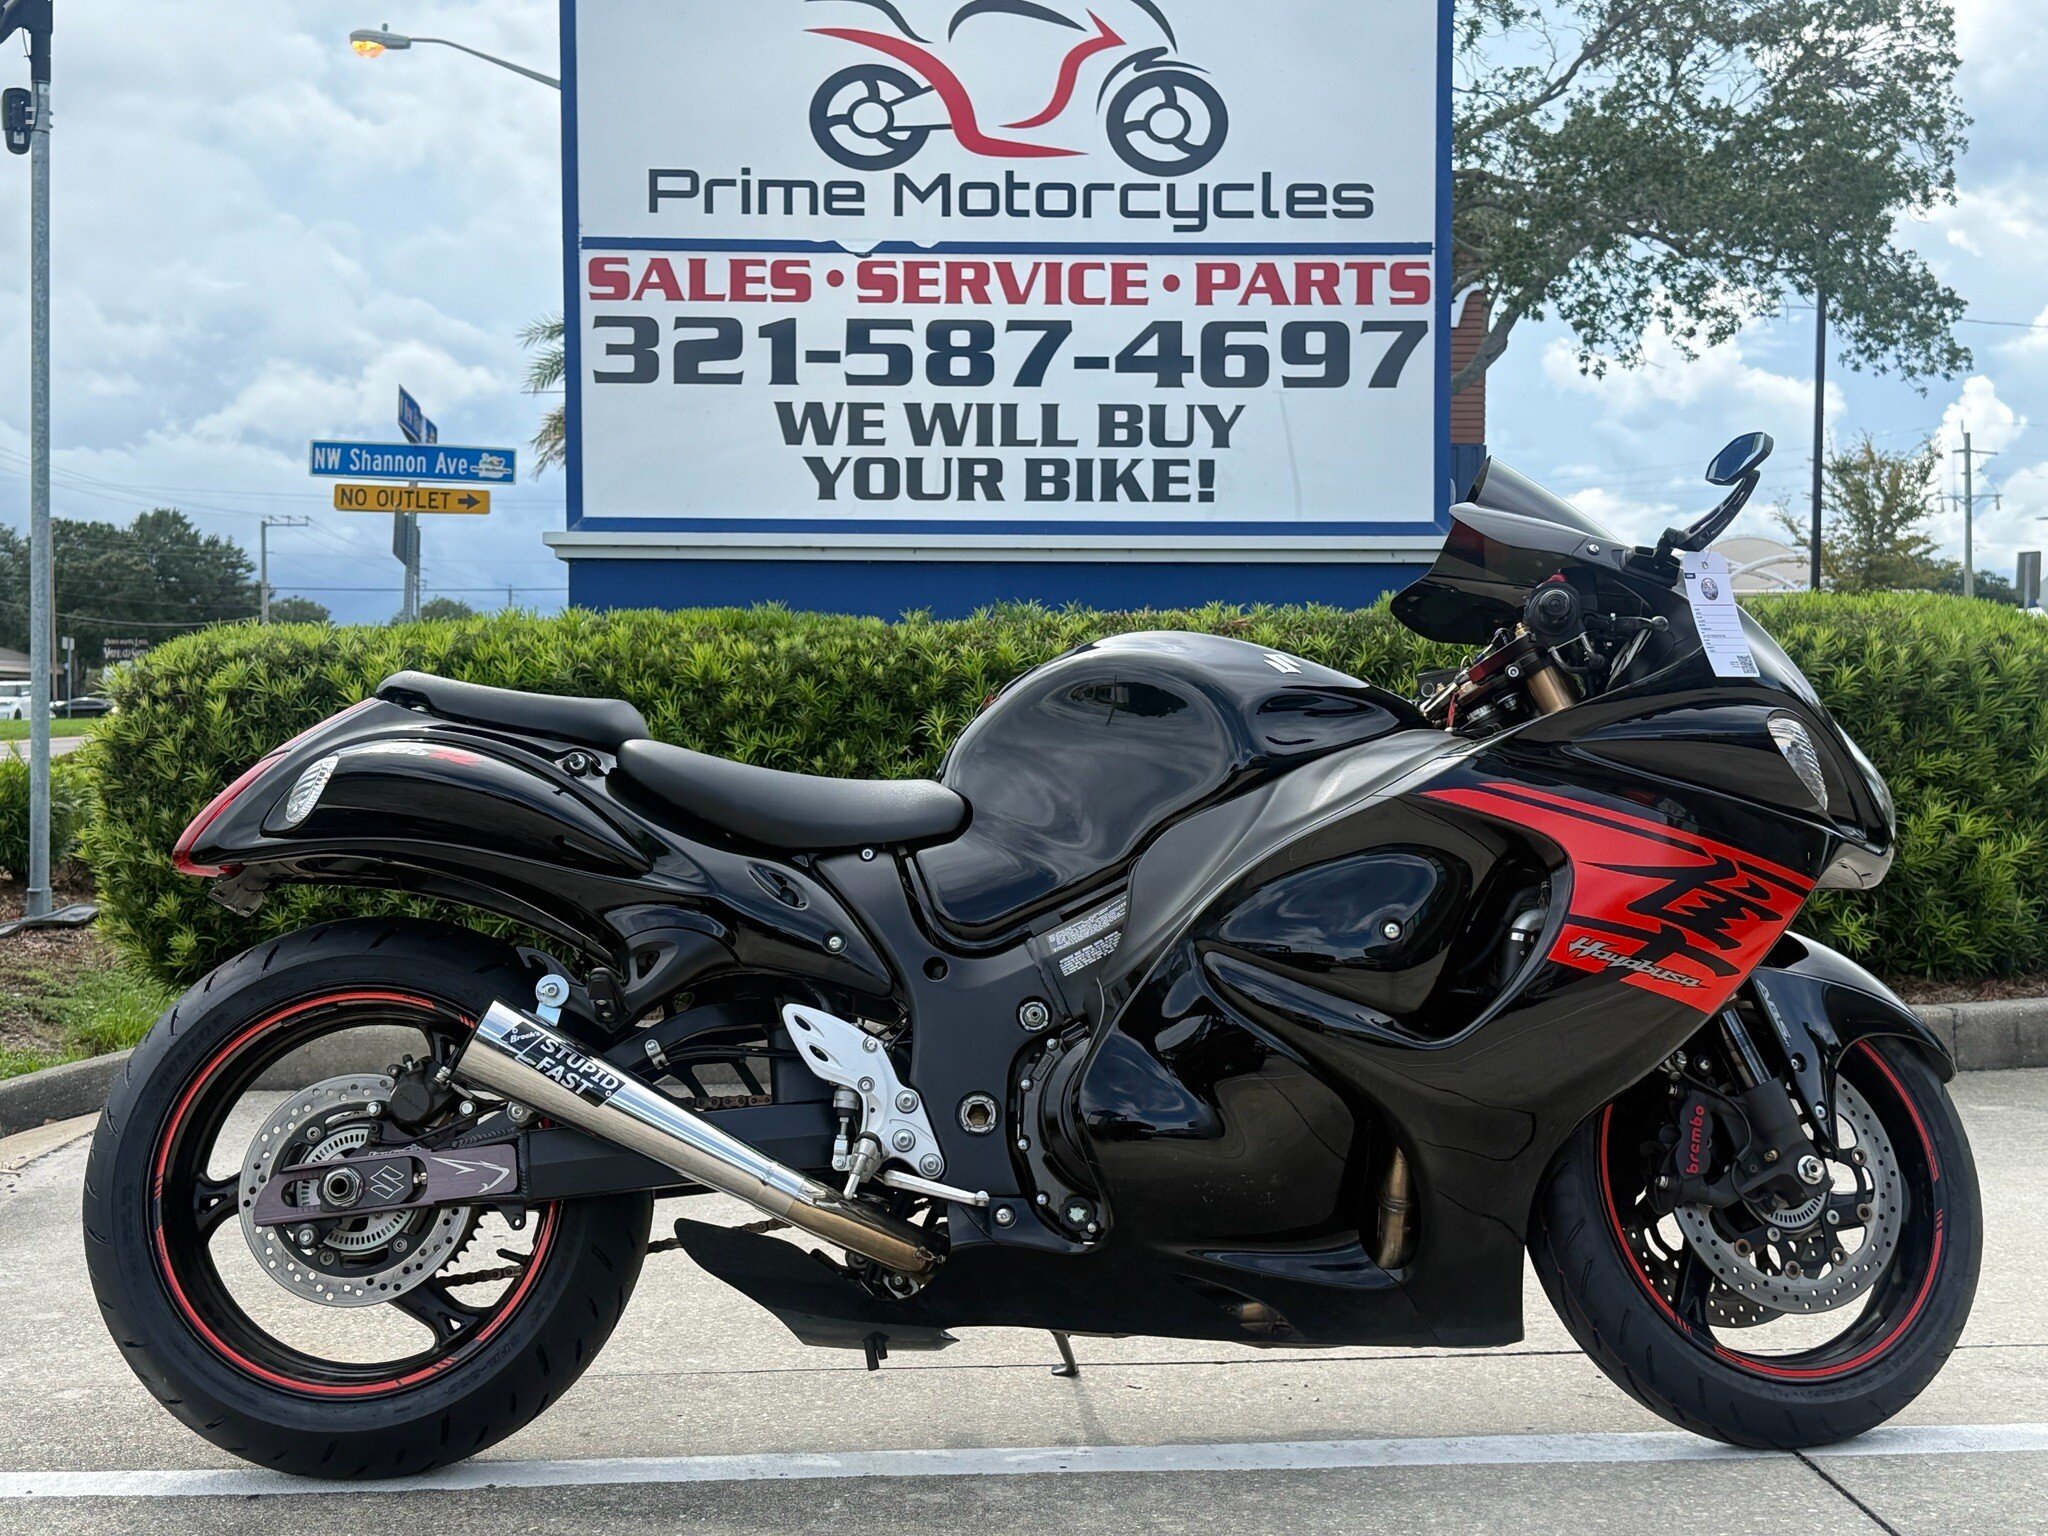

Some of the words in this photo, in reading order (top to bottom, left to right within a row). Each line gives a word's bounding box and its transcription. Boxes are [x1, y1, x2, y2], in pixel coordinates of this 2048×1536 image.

[648, 167, 865, 217] Prime
[894, 171, 1374, 233] Motorcycles
[588, 257, 812, 303] SALES
[857, 261, 1149, 305] SERVICE
[1196, 262, 1431, 306] PARTS
[592, 315, 1429, 389] 321-587-4697
[774, 402, 886, 446] WE
[903, 403, 1078, 448] WILL
[1097, 404, 1246, 449] BUY
[314, 447, 341, 470] NW
[350, 448, 427, 474] Shannon
[435, 452, 468, 475] Ave
[802, 456, 1005, 502] YOUR
[1025, 458, 1215, 503] BIKE!
[340, 488, 367, 506] NO
[376, 489, 451, 510] OUTLET
[1568, 936, 1704, 988] Hayabusa
[534, 1056, 596, 1095] FAST
[540, 1037, 619, 1090] STUPID
[1685, 1105, 1705, 1174] brembo
